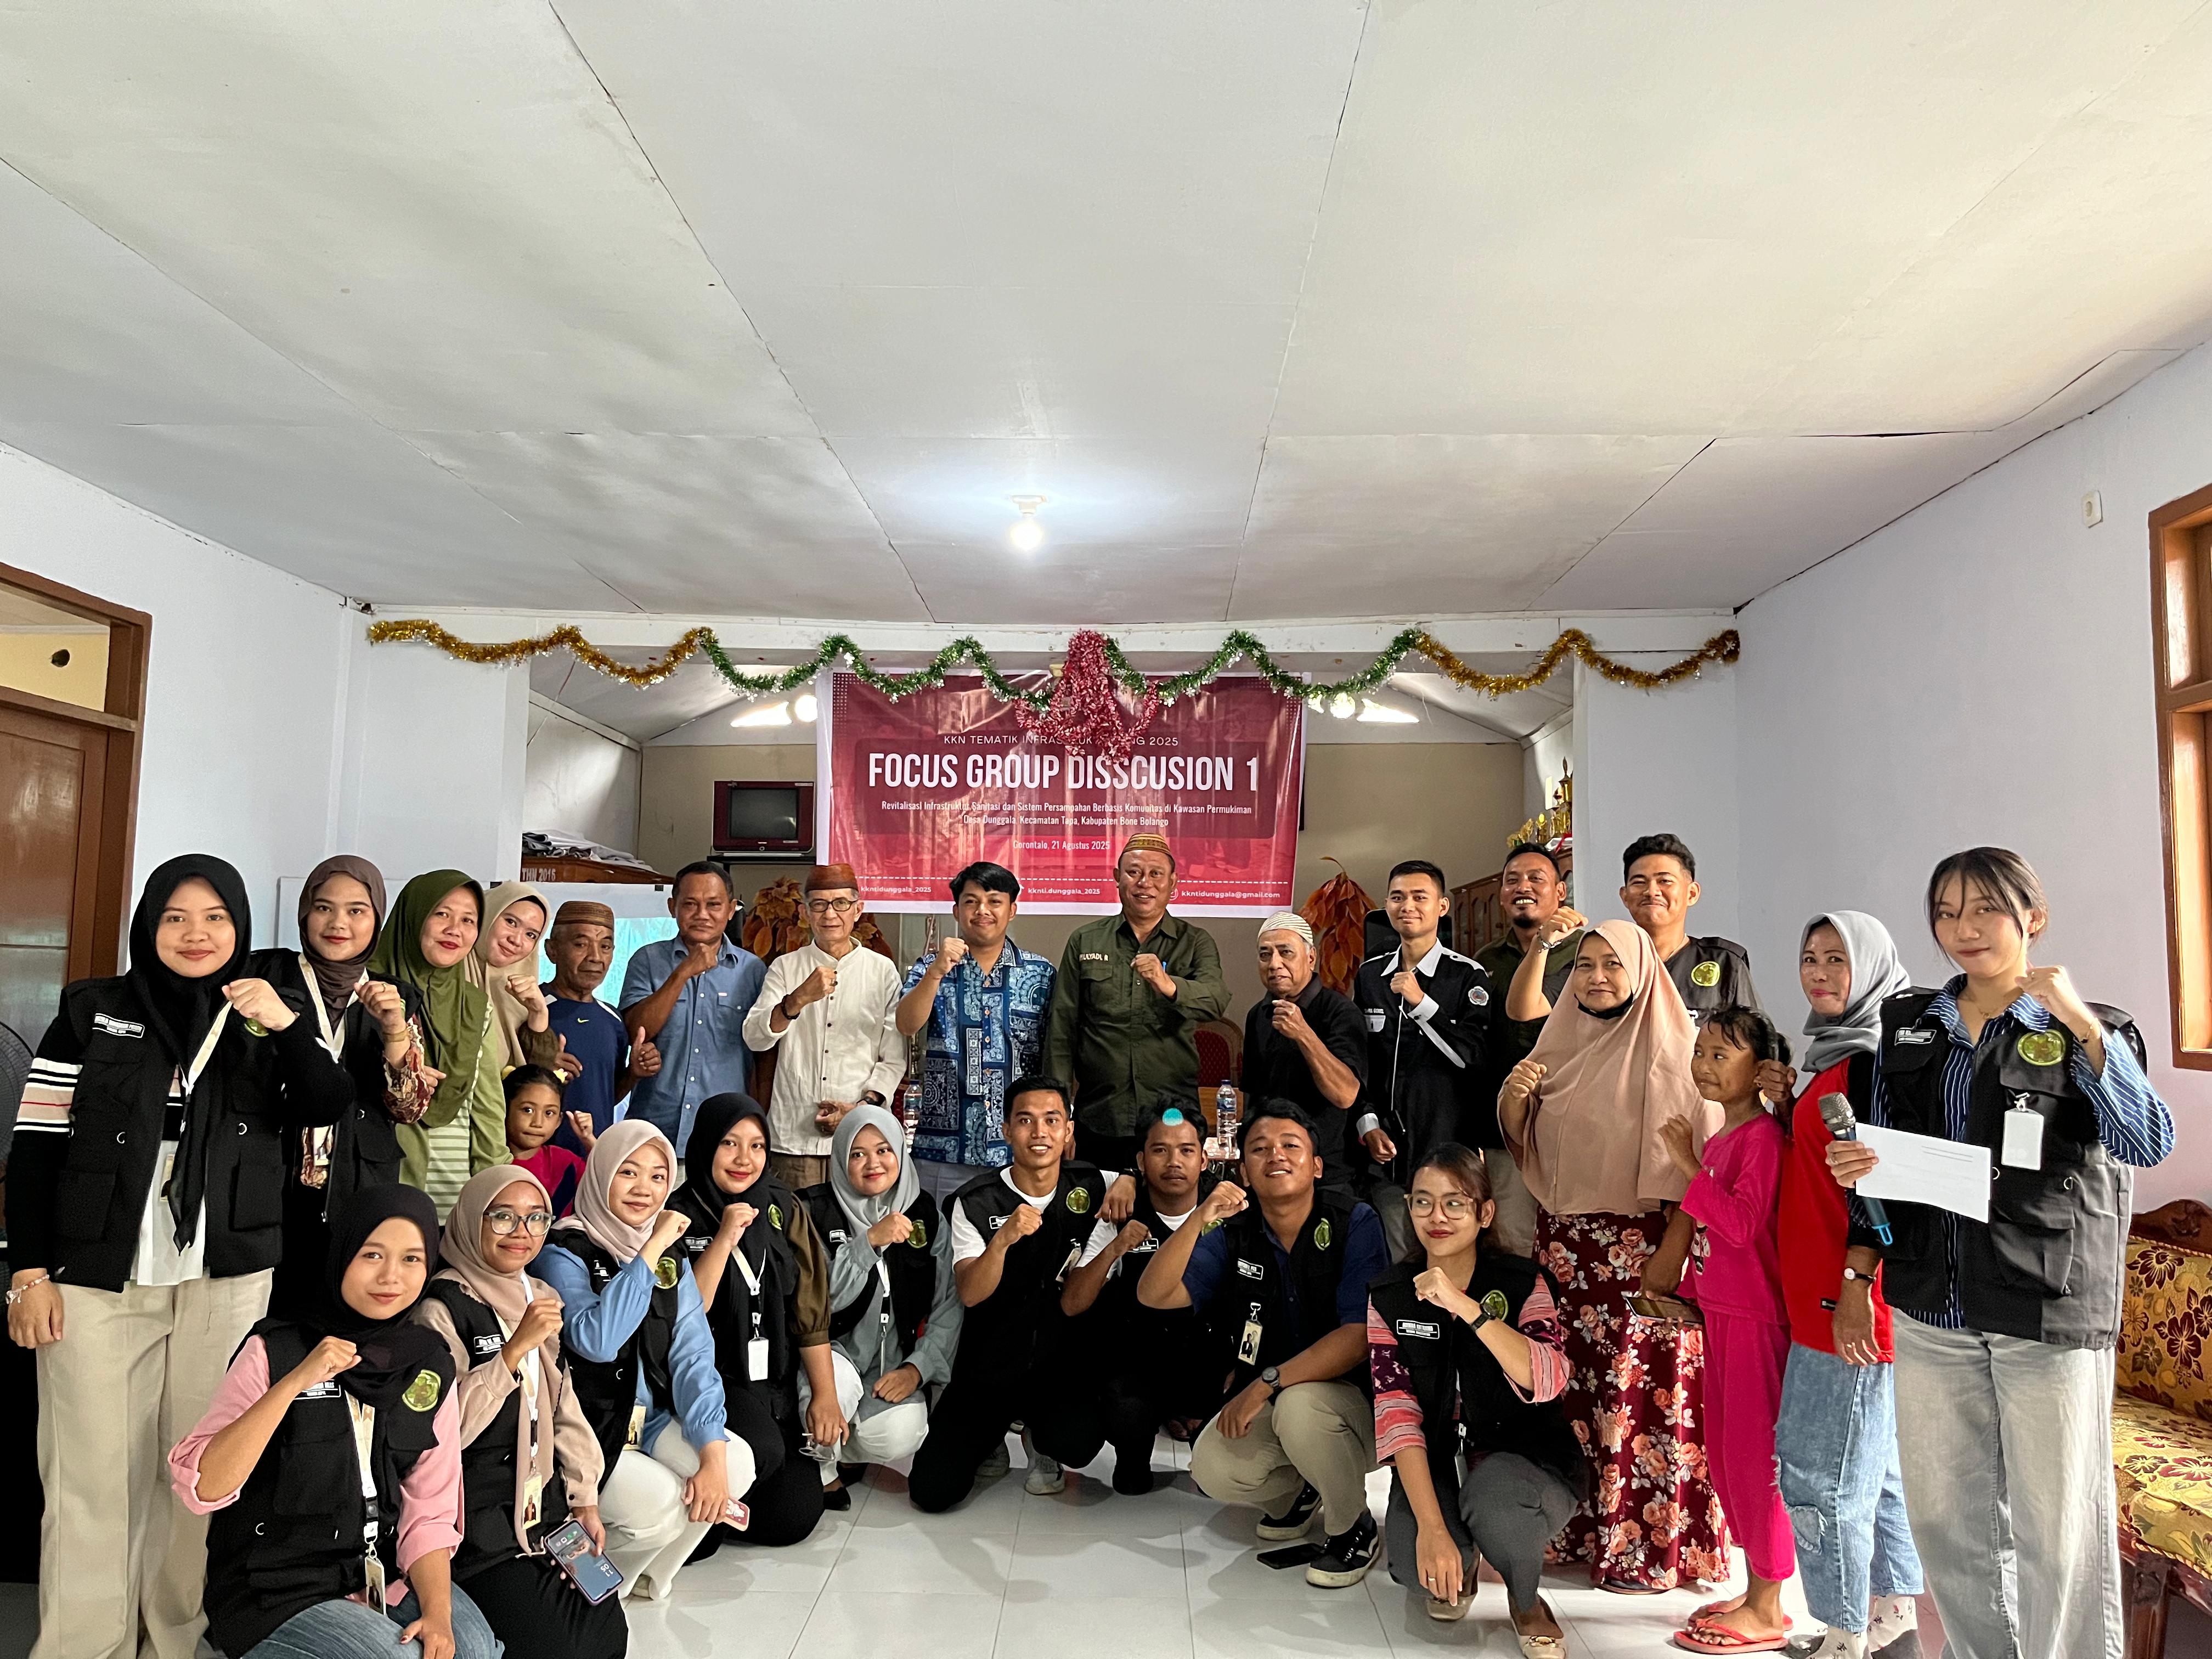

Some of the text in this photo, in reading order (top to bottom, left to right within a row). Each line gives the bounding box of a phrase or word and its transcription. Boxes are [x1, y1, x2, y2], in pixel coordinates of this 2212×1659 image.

[944, 735, 966, 744] KKN
[969, 735, 1018, 744] TEMATIK
[1149, 737, 1178, 746] 2025
[869, 752, 1258, 791] FOCUS GROUP DISSCUSION 1
[882, 800, 922, 810] Revitalisasi
[972, 802, 1000, 811] Sanitasi
[1002, 802, 1015, 811] dan
[1017, 802, 1042, 811] Sistem
[1044, 802, 1091, 813] Persampahan
[1093, 803, 1123, 812] Berbasis
[1125, 803, 1163, 812] Komunitas
[1164, 804, 1171, 812] di
[1173, 804, 1205, 813] Kawasan
[1207, 804, 1251, 814] Permukiman
[963, 815, 980, 823] Desa
[1020, 816, 1059, 825] Kecamatan
[1061, 816, 1080, 826] Tapa,
[1081, 816, 1118, 826] Kabupaten
[1120, 816, 1138, 826] Bone
[1140, 816, 1169, 827] Bolango
[1013, 840, 1110, 851] Gorontalo, 21 Agustus 2025
[522, 868, 537, 882] THN
[1181, 890, 1280, 899] kkntidunggala@gmail.com
